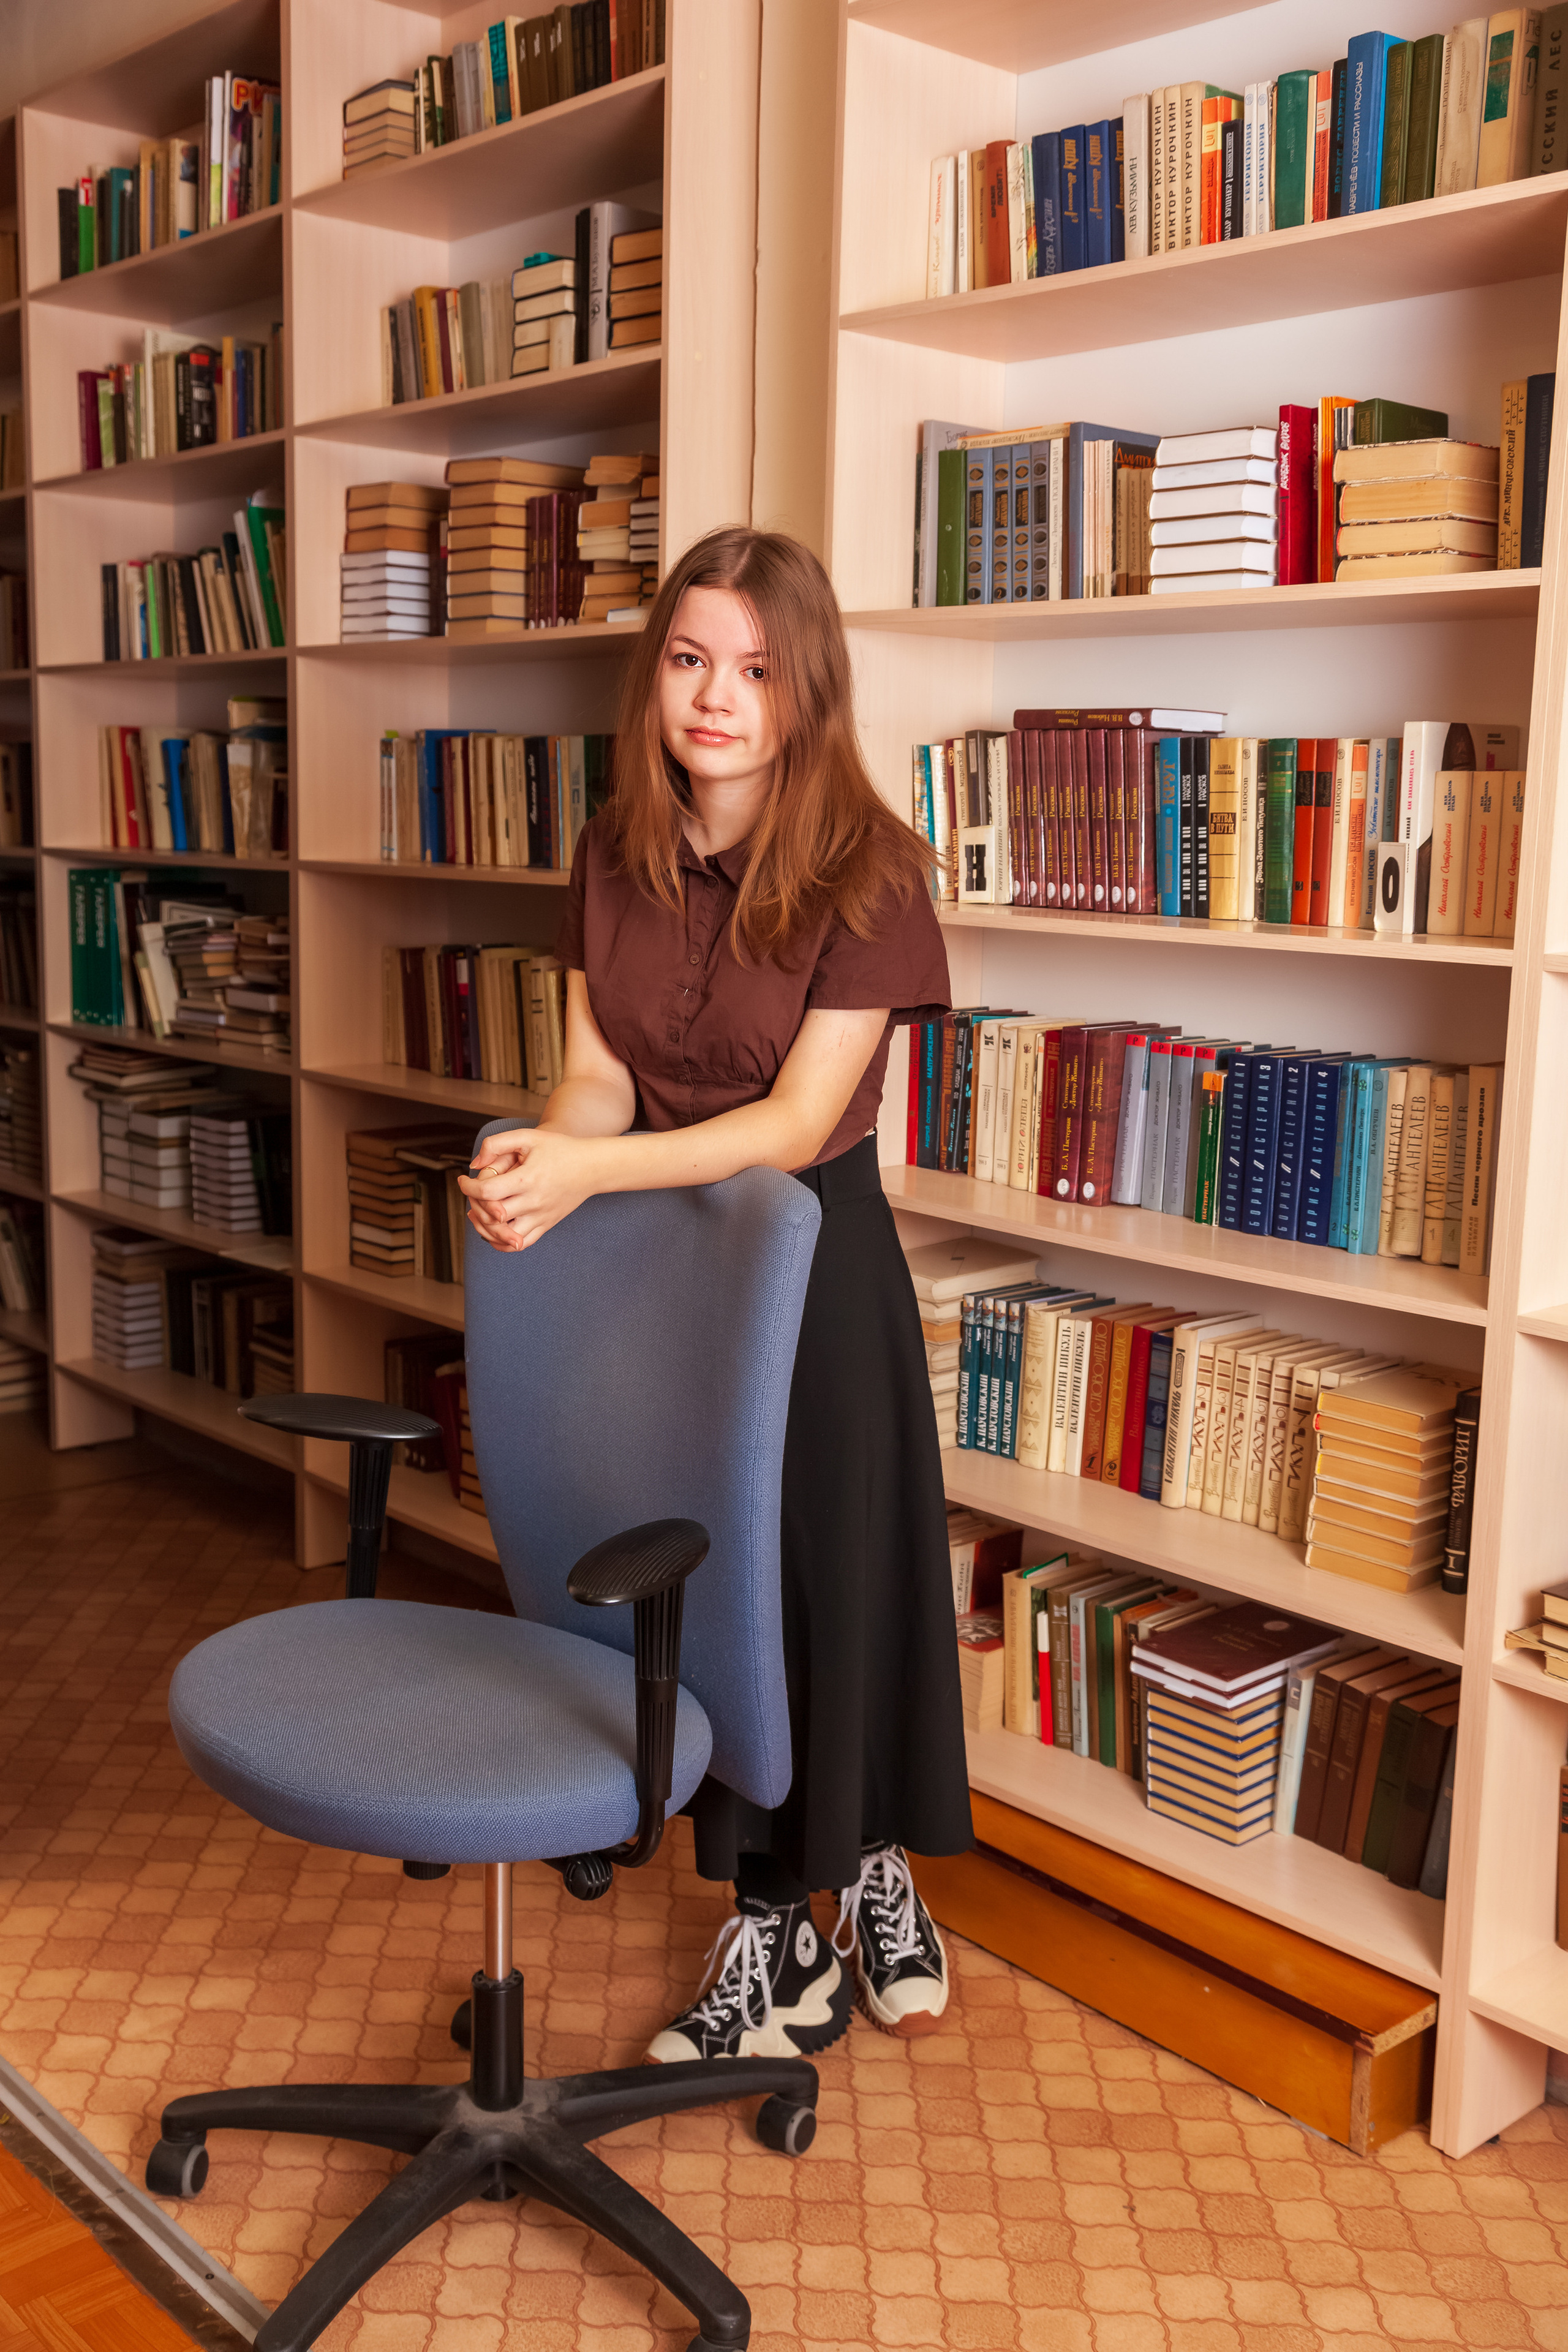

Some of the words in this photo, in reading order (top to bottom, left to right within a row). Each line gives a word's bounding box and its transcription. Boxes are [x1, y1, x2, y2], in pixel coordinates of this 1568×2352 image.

[1504, 429, 1516, 504] МИНЧКОВСКИЙ
[995, 589, 1003, 599] 2
[1374, 747, 1383, 794] шлемоносцы
[1210, 823, 1215, 834] В
[1216, 823, 1234, 834] ПУТИ
[1212, 813, 1233, 824] БИТВА
[1257, 797, 1266, 829] Петушка
[1368, 797, 1379, 840] Усвятские
[1256, 829, 1265, 861] Золотого
[1441, 823, 1453, 873] Островский
[1476, 825, 1488, 876] Островский
[1507, 824, 1520, 876] Островский
[1256, 861, 1264, 884] Город
[1365, 884, 1374, 915] Евгений
[1438, 878, 1449, 916] Николай
[1473, 881, 1484, 919] Николай
[1504, 881, 1515, 919] Николай
[1063, 1063, 1071, 1109] Стихотворения
[1088, 1066, 1096, 1112] Стихотворения
[1477, 1087, 1485, 1127] дрозда
[1018, 1098, 1028, 1137] ОЛЕША
[1063, 1117, 1072, 1152] Пастернак
[1088, 1120, 1097, 1155] Пастернак
[1229, 1072, 1245, 1167] ПАСТЕРНАК
[1253, 1074, 1270, 1170] ПАСТЕРНАК
[1281, 1077, 1298, 1174] ПАСТЕРНАК
[1310, 1082, 1329, 1179] ПАСТЕРНАК
[1017, 1139, 1025, 1174] ЮРИЙ
[1062, 1153, 1069, 1162] Л.
[1088, 1156, 1095, 1166] Л.
[1120, 1125, 1129, 1172] ПАСТЕРНАК
[1150, 1133, 1159, 1180] ПАСТЕРНАК
[1172, 1136, 1182, 1184] ПАСТЕРНАК
[1474, 1130, 1483, 1172] черного
[1225, 1172, 1238, 1223] БОРИС
[1249, 1177, 1264, 1227] БОРИС
[1277, 1181, 1292, 1232] БОРИС
[1305, 1187, 1320, 1238] БОРИС
[1471, 1175, 1480, 1207] Песни
[1059, 1326, 1072, 1368] ПИКУЛЬ
[1074, 1331, 1086, 1373] ПИКУЛЬ
[1115, 1327, 1127, 1366] ДЕЛО
[959, 1371, 970, 1434] ПАУСТОВСКИЙ
[978, 1373, 989, 1437] ПАУСТОВСКИЙ
[987, 1377, 1000, 1441] ПАУСТОВСКИЙ
[1001, 1380, 1013, 1444] ПАУСТОВСКИЙ
[1054, 1371, 1068, 1429] ВАЛЕНТИН
[1069, 1376, 1082, 1434] ВАЛЕНТИН
[1110, 1368, 1125, 1418] СЛОВО
[1170, 1390, 1182, 1428] ПИКУЛЬ
[1196, 1387, 1207, 1400] 2
[1217, 1391, 1227, 1404] 3
[1234, 1398, 1245, 1411] 4
[1275, 1406, 1286, 1419] 6
[959, 1435, 967, 1445] К.
[977, 1438, 986, 1448] К.
[987, 1441, 997, 1452] К.
[1001, 1445, 1010, 1455] К.
[1191, 1401, 1206, 1458] ПИКУЛЬ
[1211, 1406, 1226, 1463] ПИКУЛЬ
[1229, 1412, 1245, 1468] ПИКУЛЬ
[1165, 1430, 1178, 1479] ВАЛЕНТИН
[1268, 1420, 1287, 1483] ПИКУЛЬ
[1450, 1427, 1471, 1507] ФАВОРИТ
